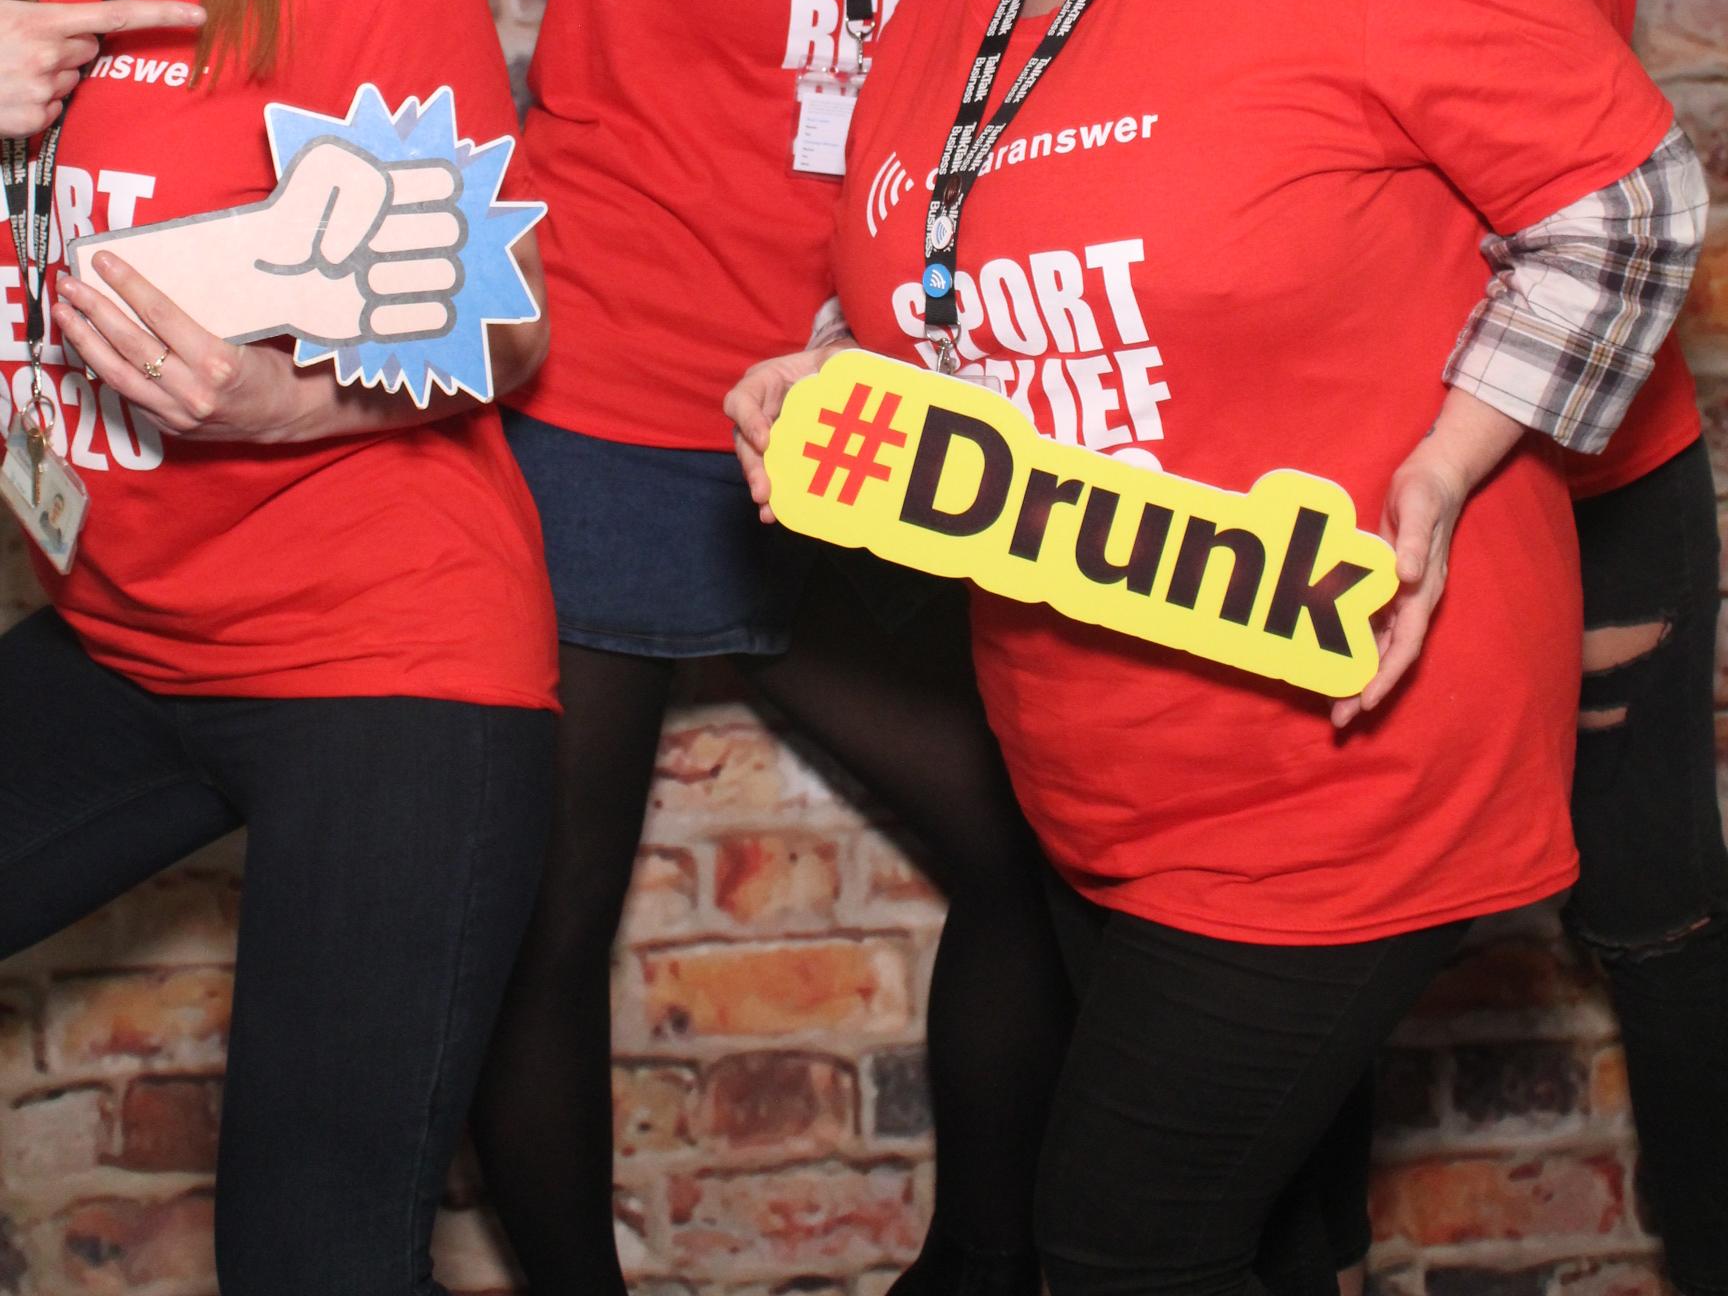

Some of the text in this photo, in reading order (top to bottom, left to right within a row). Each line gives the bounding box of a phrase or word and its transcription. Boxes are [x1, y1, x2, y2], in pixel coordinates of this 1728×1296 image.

[962, 57, 986, 104] Business
[974, 53, 1001, 103] TalkTalk
[1004, 57, 1039, 103] Business
[1013, 57, 1051, 104] TalkTalk
[939, 126, 963, 176] Business
[950, 122, 977, 175] TalkTalk
[968, 123, 1006, 172] TalkTalk
[803, 382, 1374, 659] #Drunk
